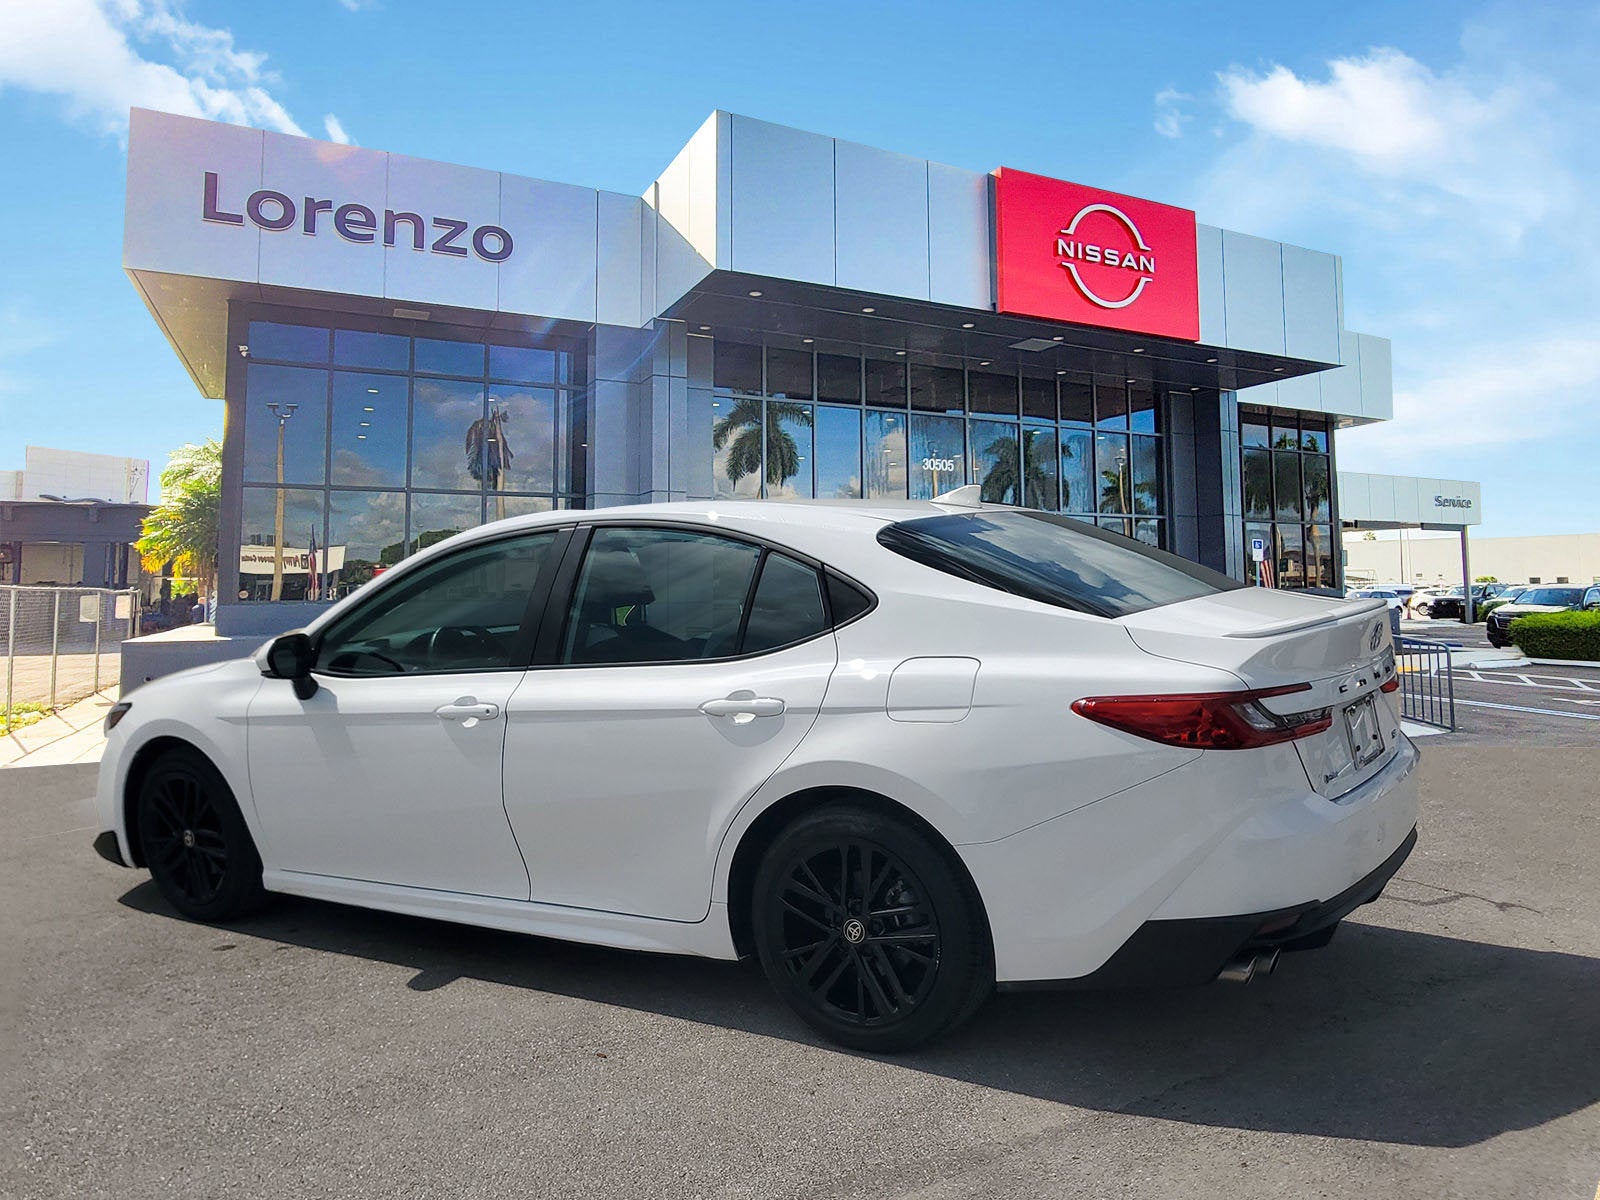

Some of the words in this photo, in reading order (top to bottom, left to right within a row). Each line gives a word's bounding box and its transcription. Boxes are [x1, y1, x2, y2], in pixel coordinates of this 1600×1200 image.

[202, 171, 513, 262] Lorenzo
[1057, 238, 1155, 273] NISSAN
[922, 458, 955, 472] 30505
[1434, 495, 1472, 507] Service
